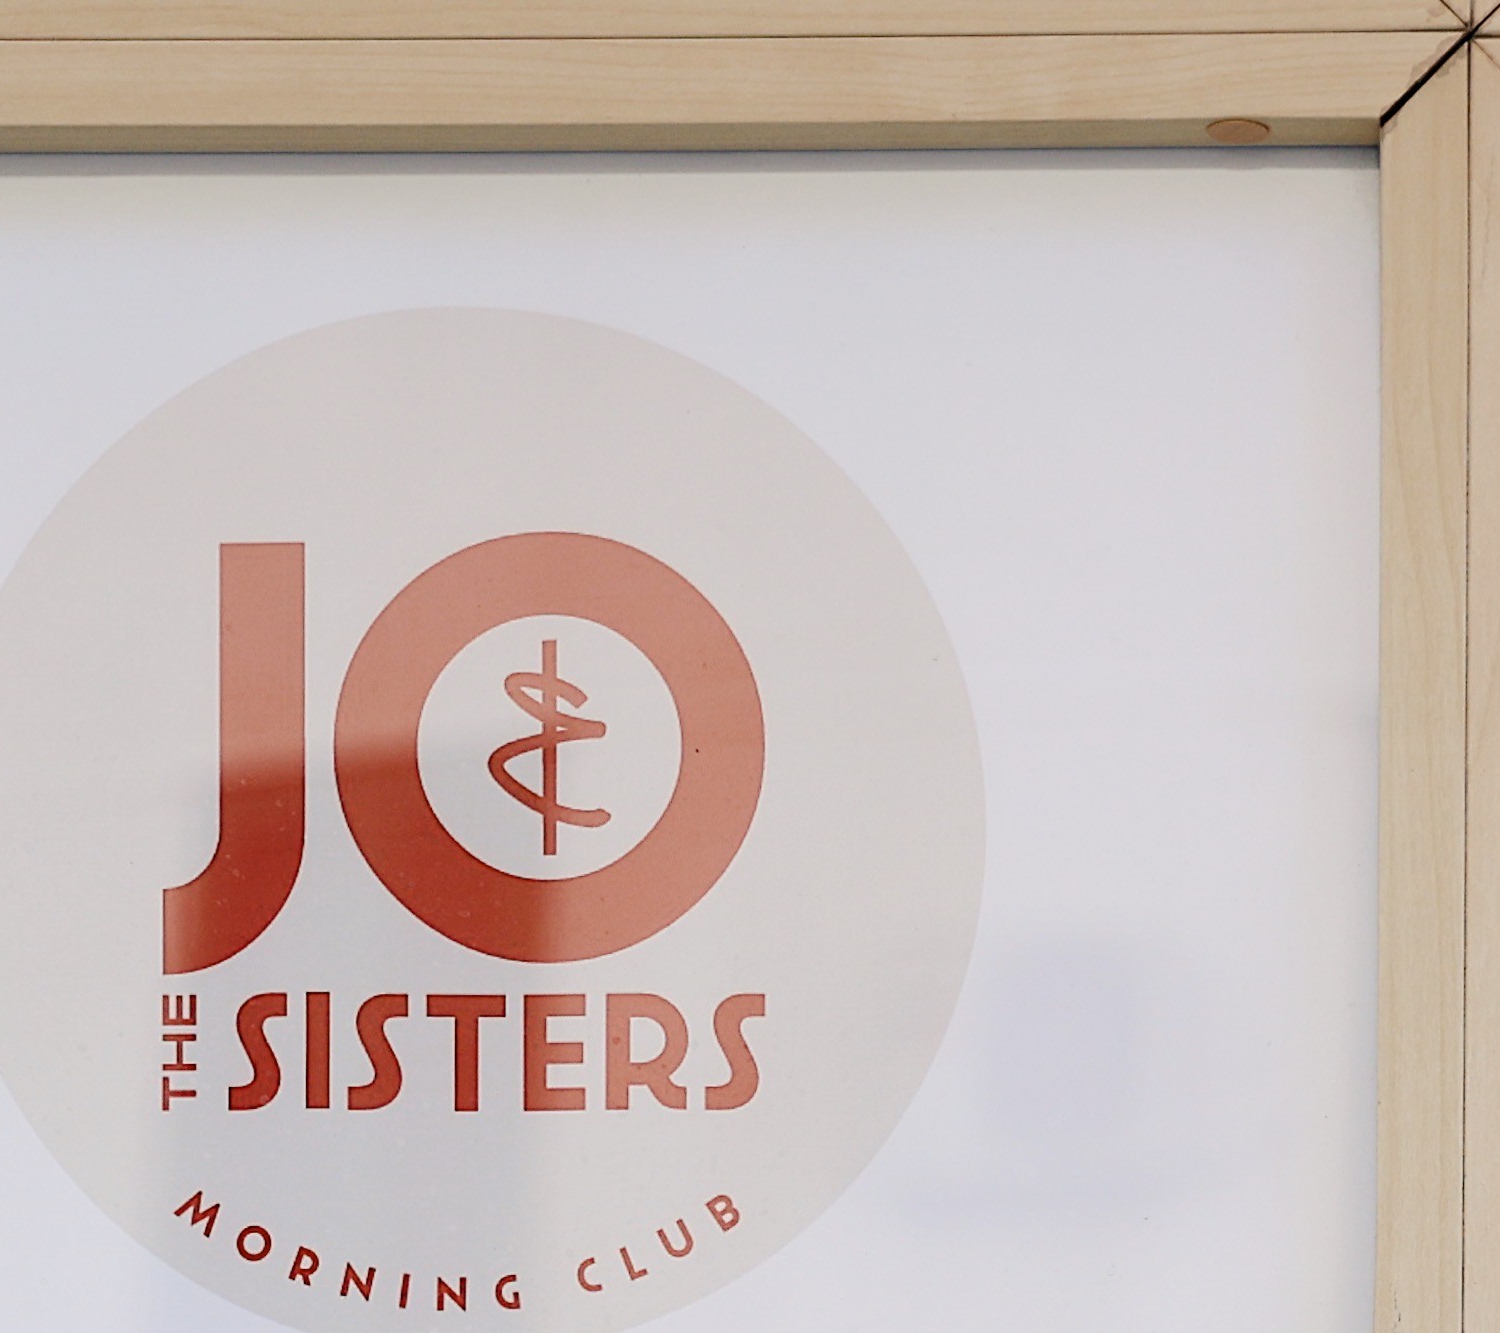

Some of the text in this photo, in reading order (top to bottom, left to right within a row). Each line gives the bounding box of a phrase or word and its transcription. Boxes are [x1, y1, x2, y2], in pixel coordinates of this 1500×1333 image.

[163, 531, 765, 975] JO
[162, 992, 766, 1112] THE SISTERS
[174, 1191, 741, 1311] MORNING CLUB
